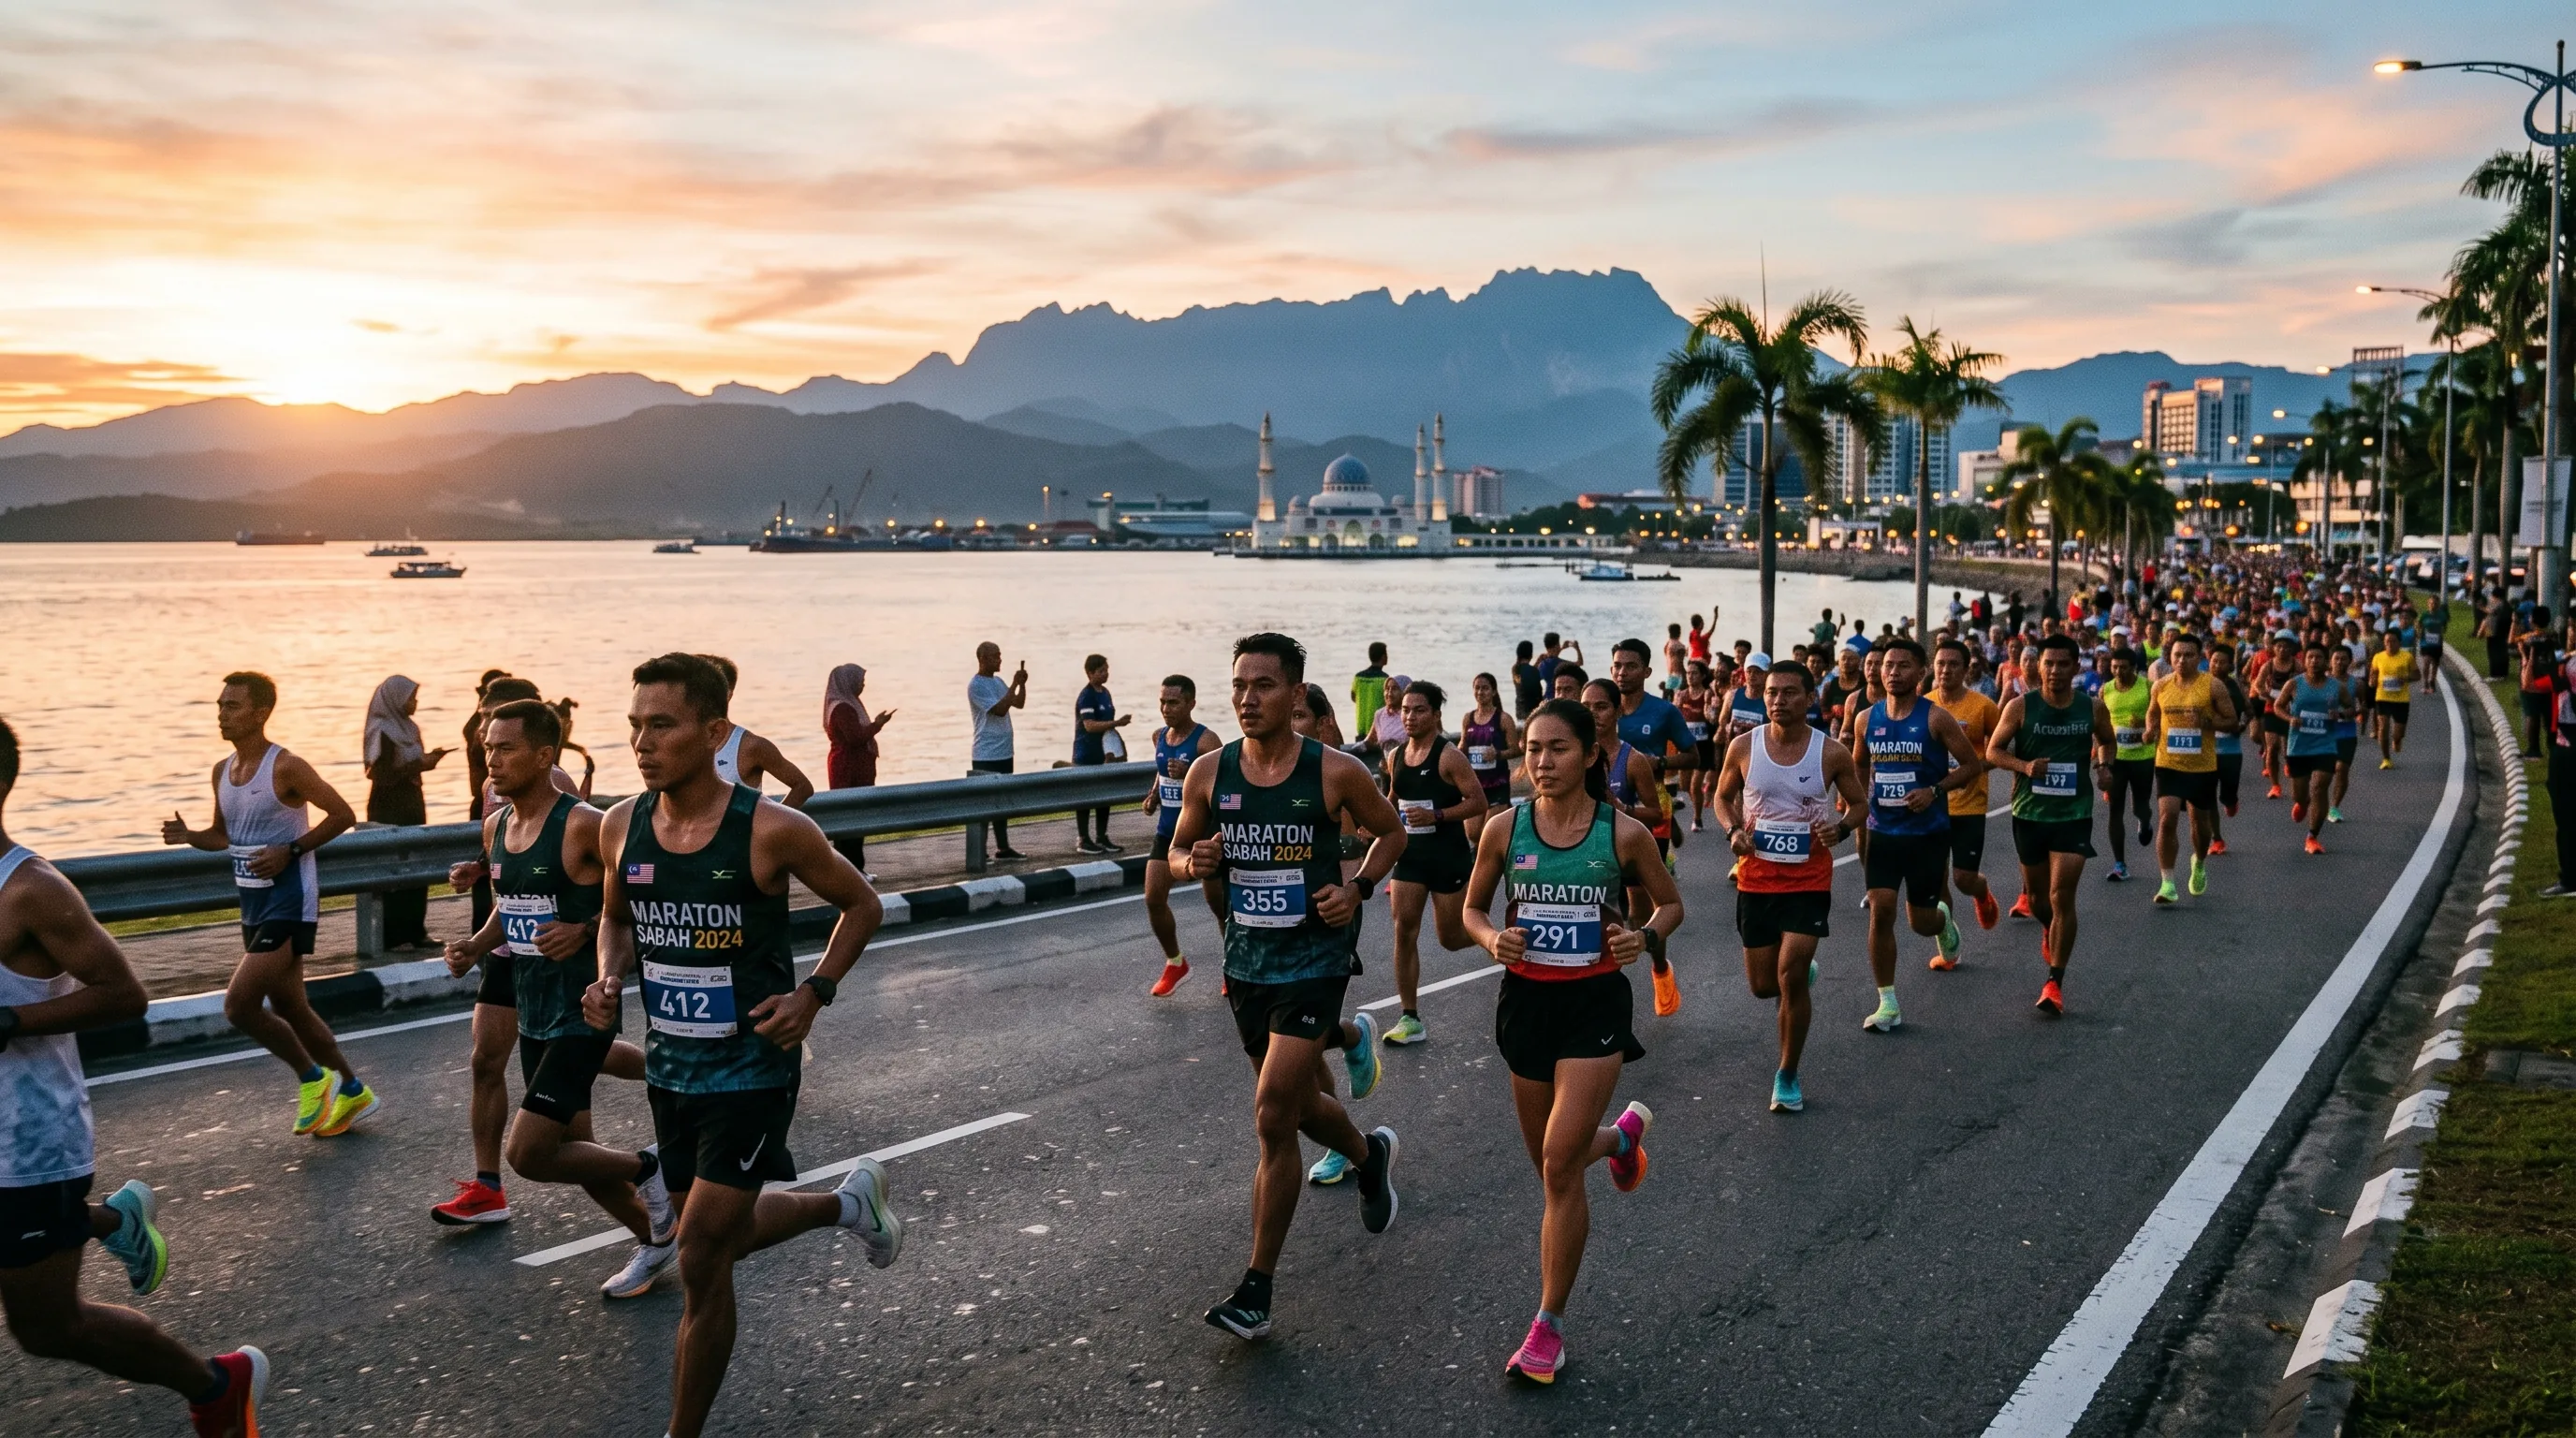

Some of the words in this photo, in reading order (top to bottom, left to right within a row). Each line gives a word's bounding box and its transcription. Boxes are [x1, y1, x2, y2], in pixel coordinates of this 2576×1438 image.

[1869, 741, 1923, 755] MARATON
[1220, 823, 1314, 844] MARATON
[1764, 833, 1798, 853] 768
[1223, 843, 1271, 861] SABAH
[1274, 845, 1313, 861] 2024
[1241, 888, 1288, 913] 355
[1514, 883, 1607, 904] MARATON
[629, 900, 742, 928] MARATON
[507, 917, 539, 941] 412
[637, 924, 690, 948] SABAH
[695, 929, 744, 949] 2024
[1531, 924, 1578, 949] 291
[659, 990, 711, 1019] 412
